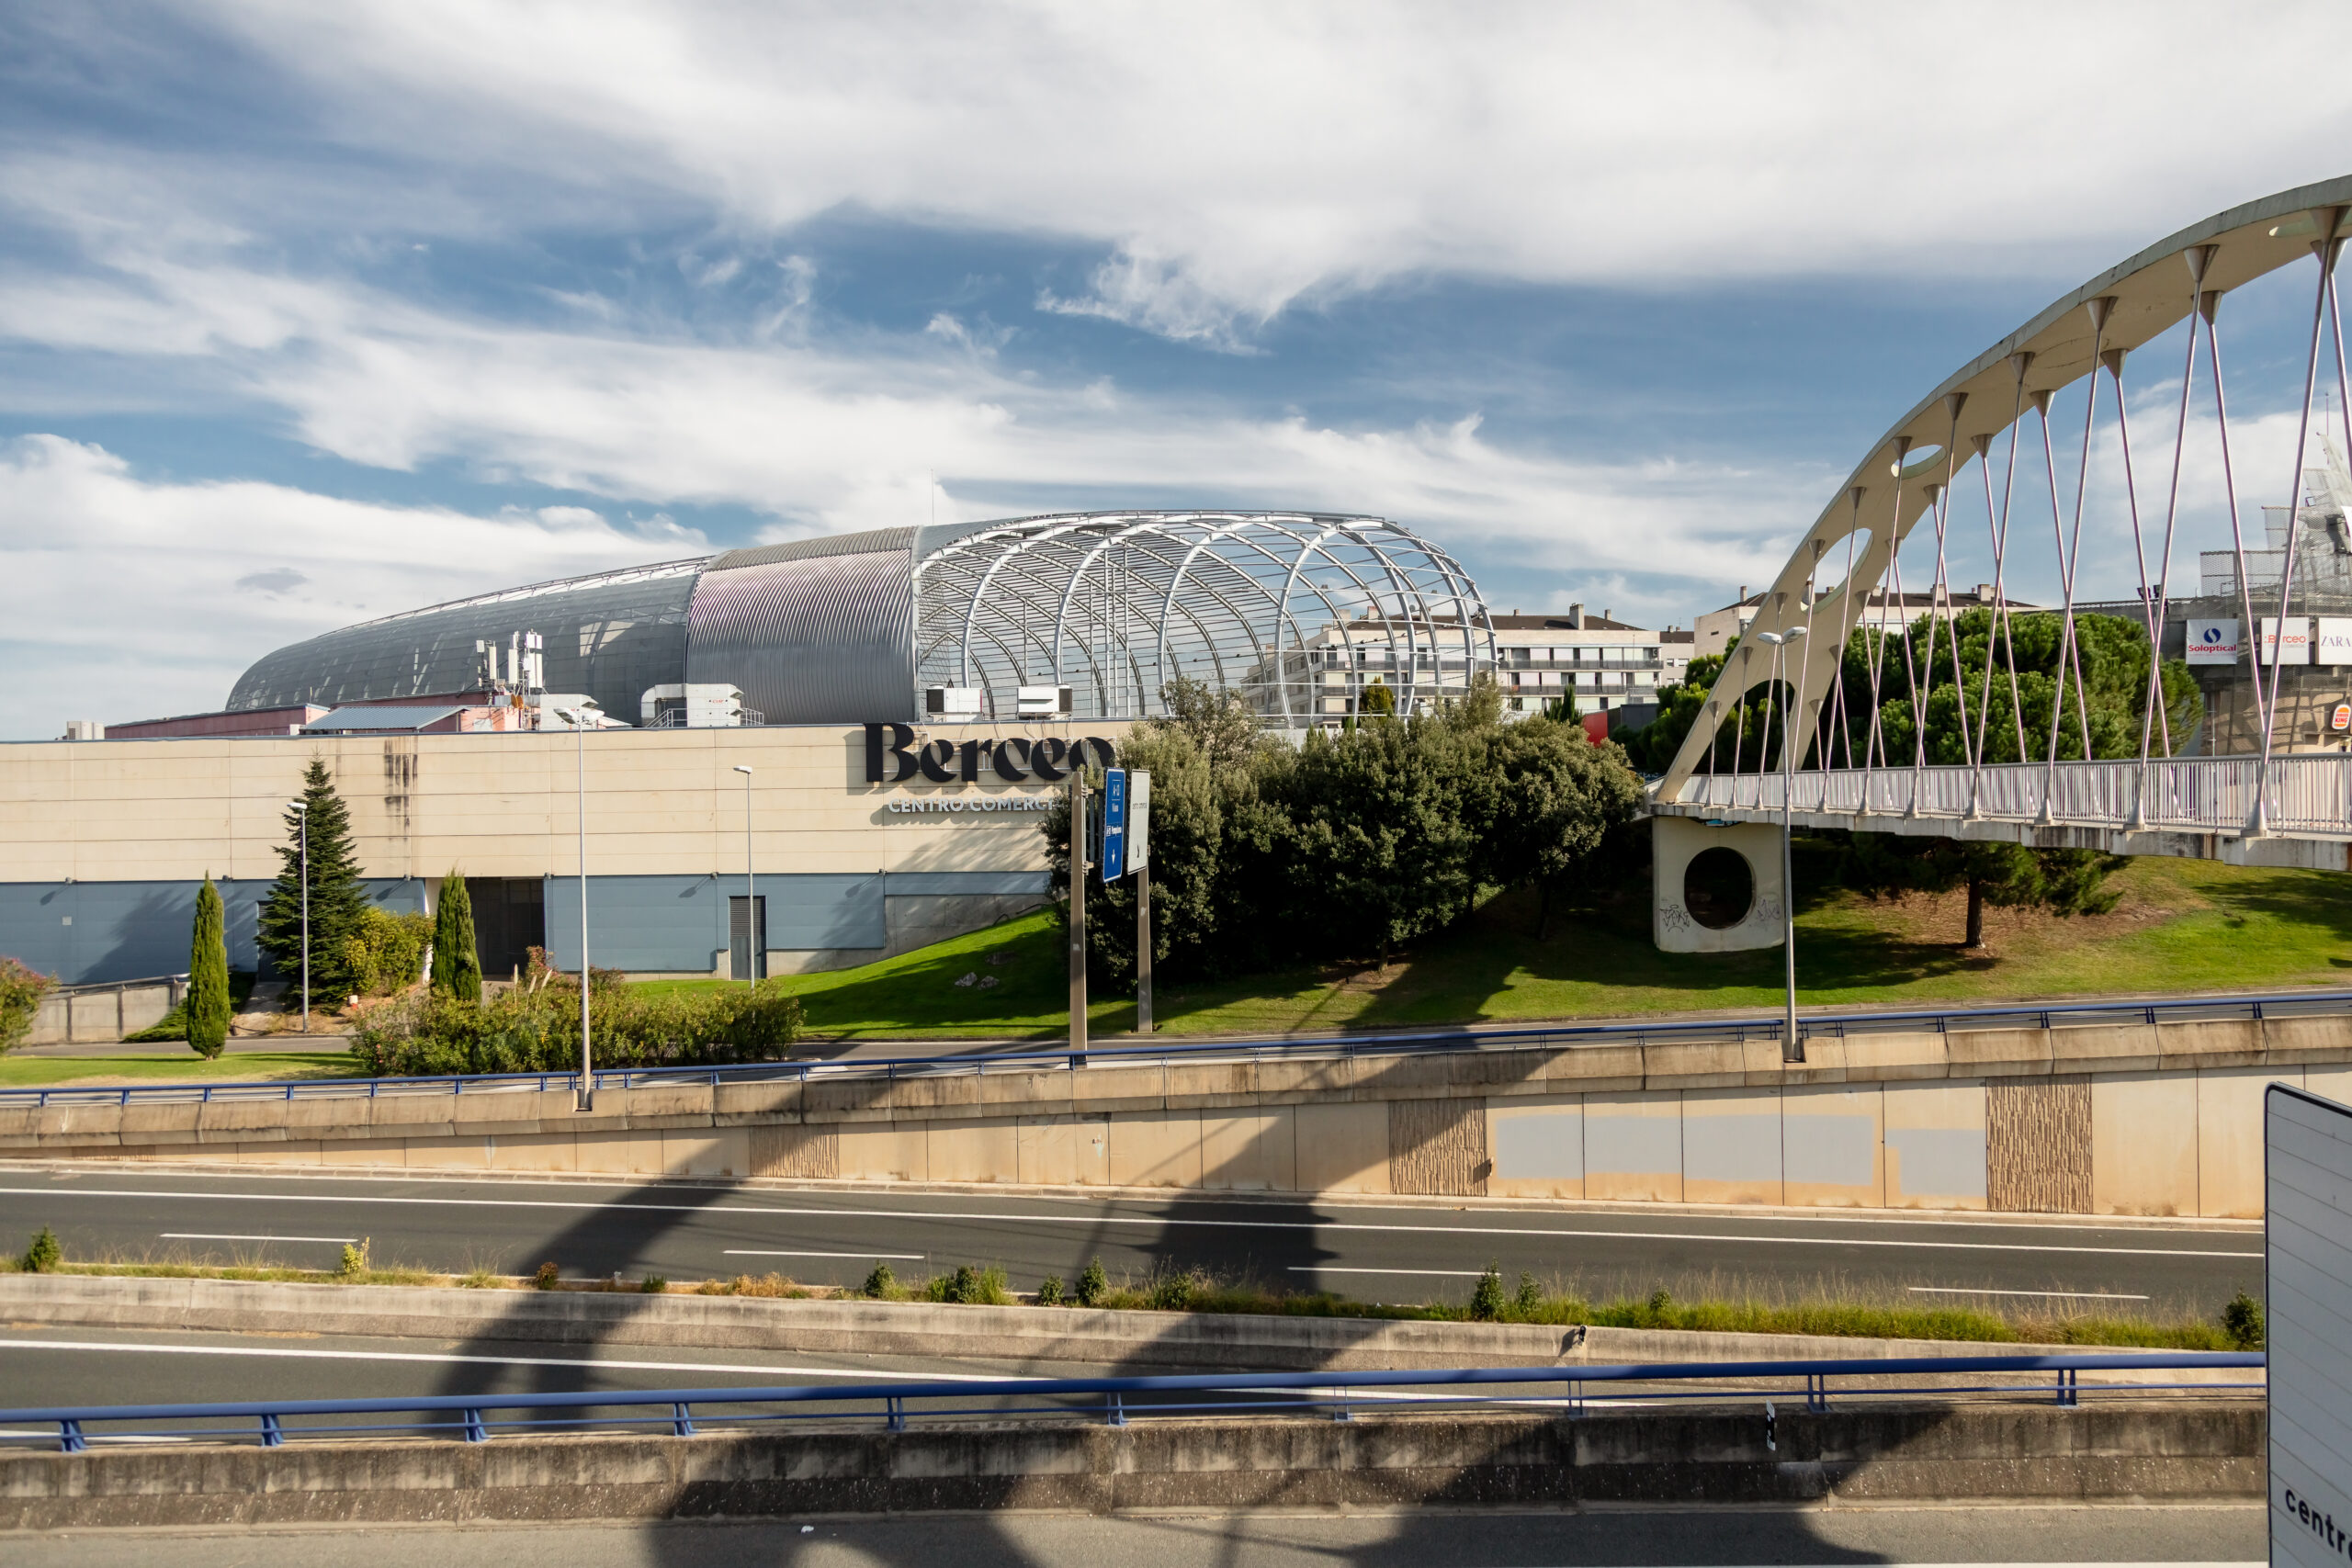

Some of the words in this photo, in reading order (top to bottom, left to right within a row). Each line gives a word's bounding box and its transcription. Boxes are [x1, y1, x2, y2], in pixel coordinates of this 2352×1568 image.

[2321, 636, 2351, 647] ZARA
[2188, 644, 2236, 653] Soloptical
[862, 723, 1115, 783] Berceo
[888, 797, 964, 813] CENTRO
